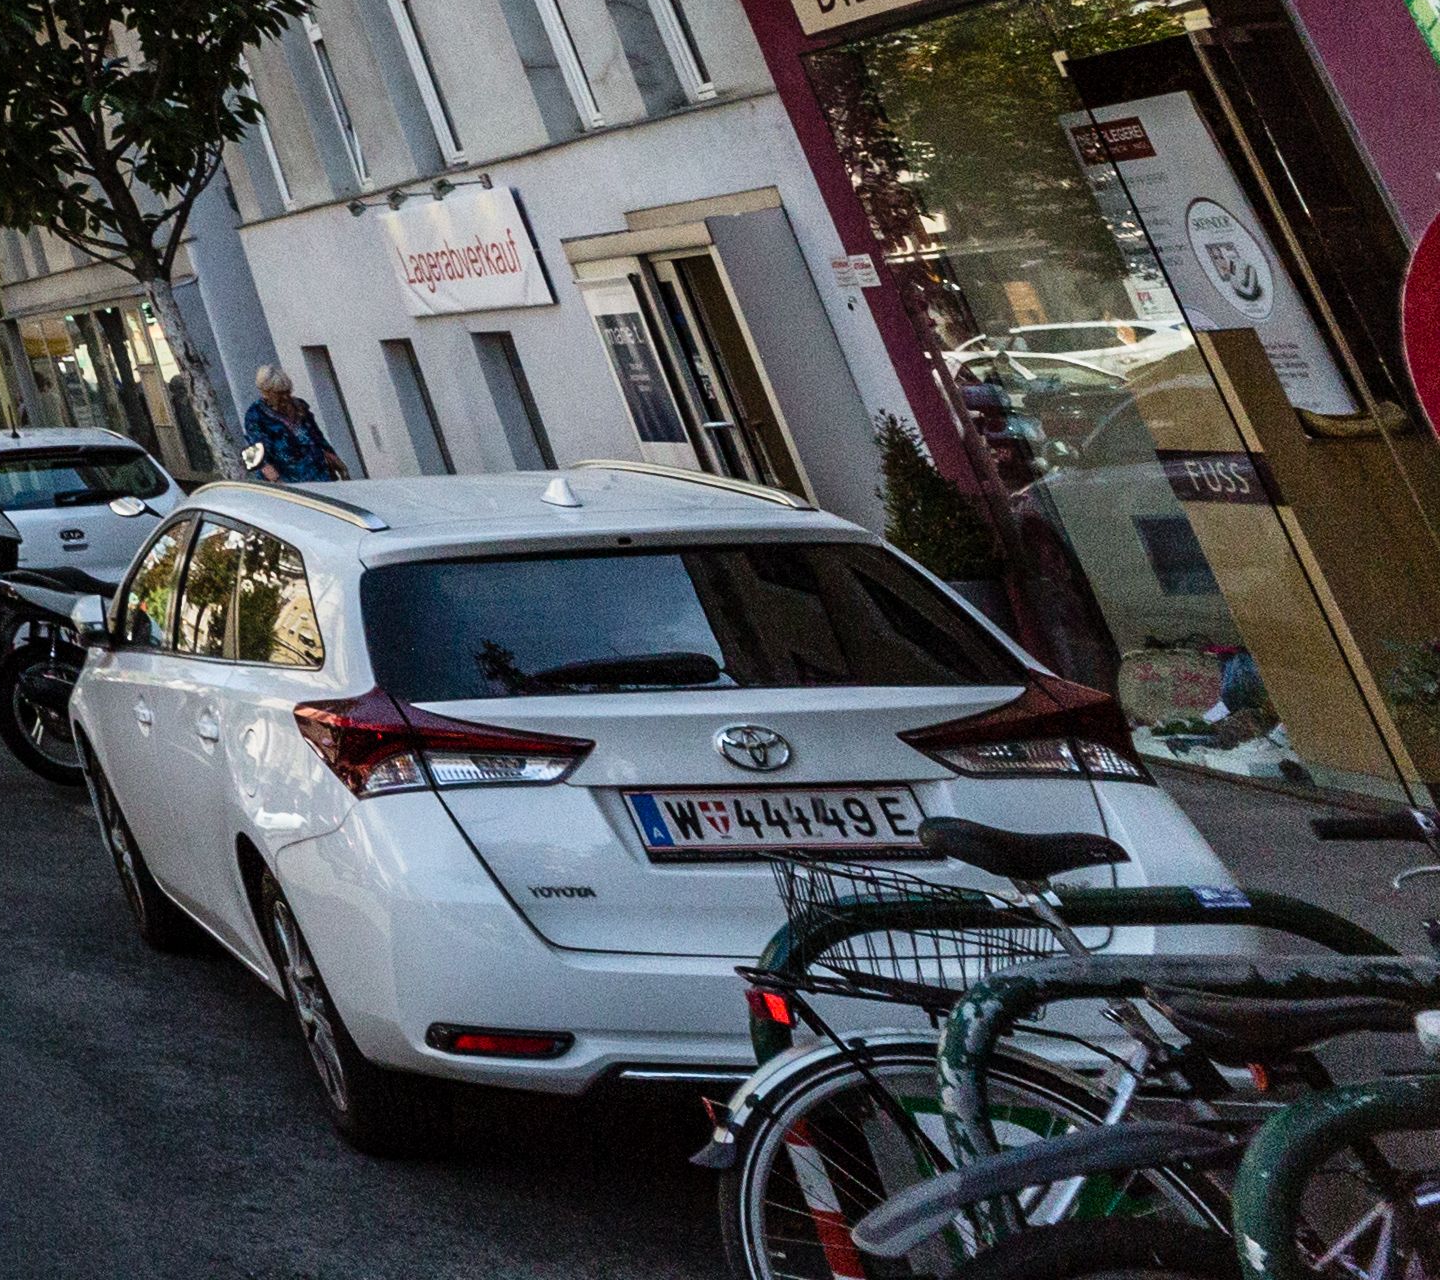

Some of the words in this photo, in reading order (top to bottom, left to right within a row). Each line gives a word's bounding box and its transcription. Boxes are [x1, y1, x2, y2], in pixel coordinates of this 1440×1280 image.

[396, 227, 522, 293] Lagerabverkauf
[1183, 459, 1250, 494] FUSS
[663, 799, 704, 840] W
[733, 796, 878, 840] 44449
[876, 796, 916, 837] E
